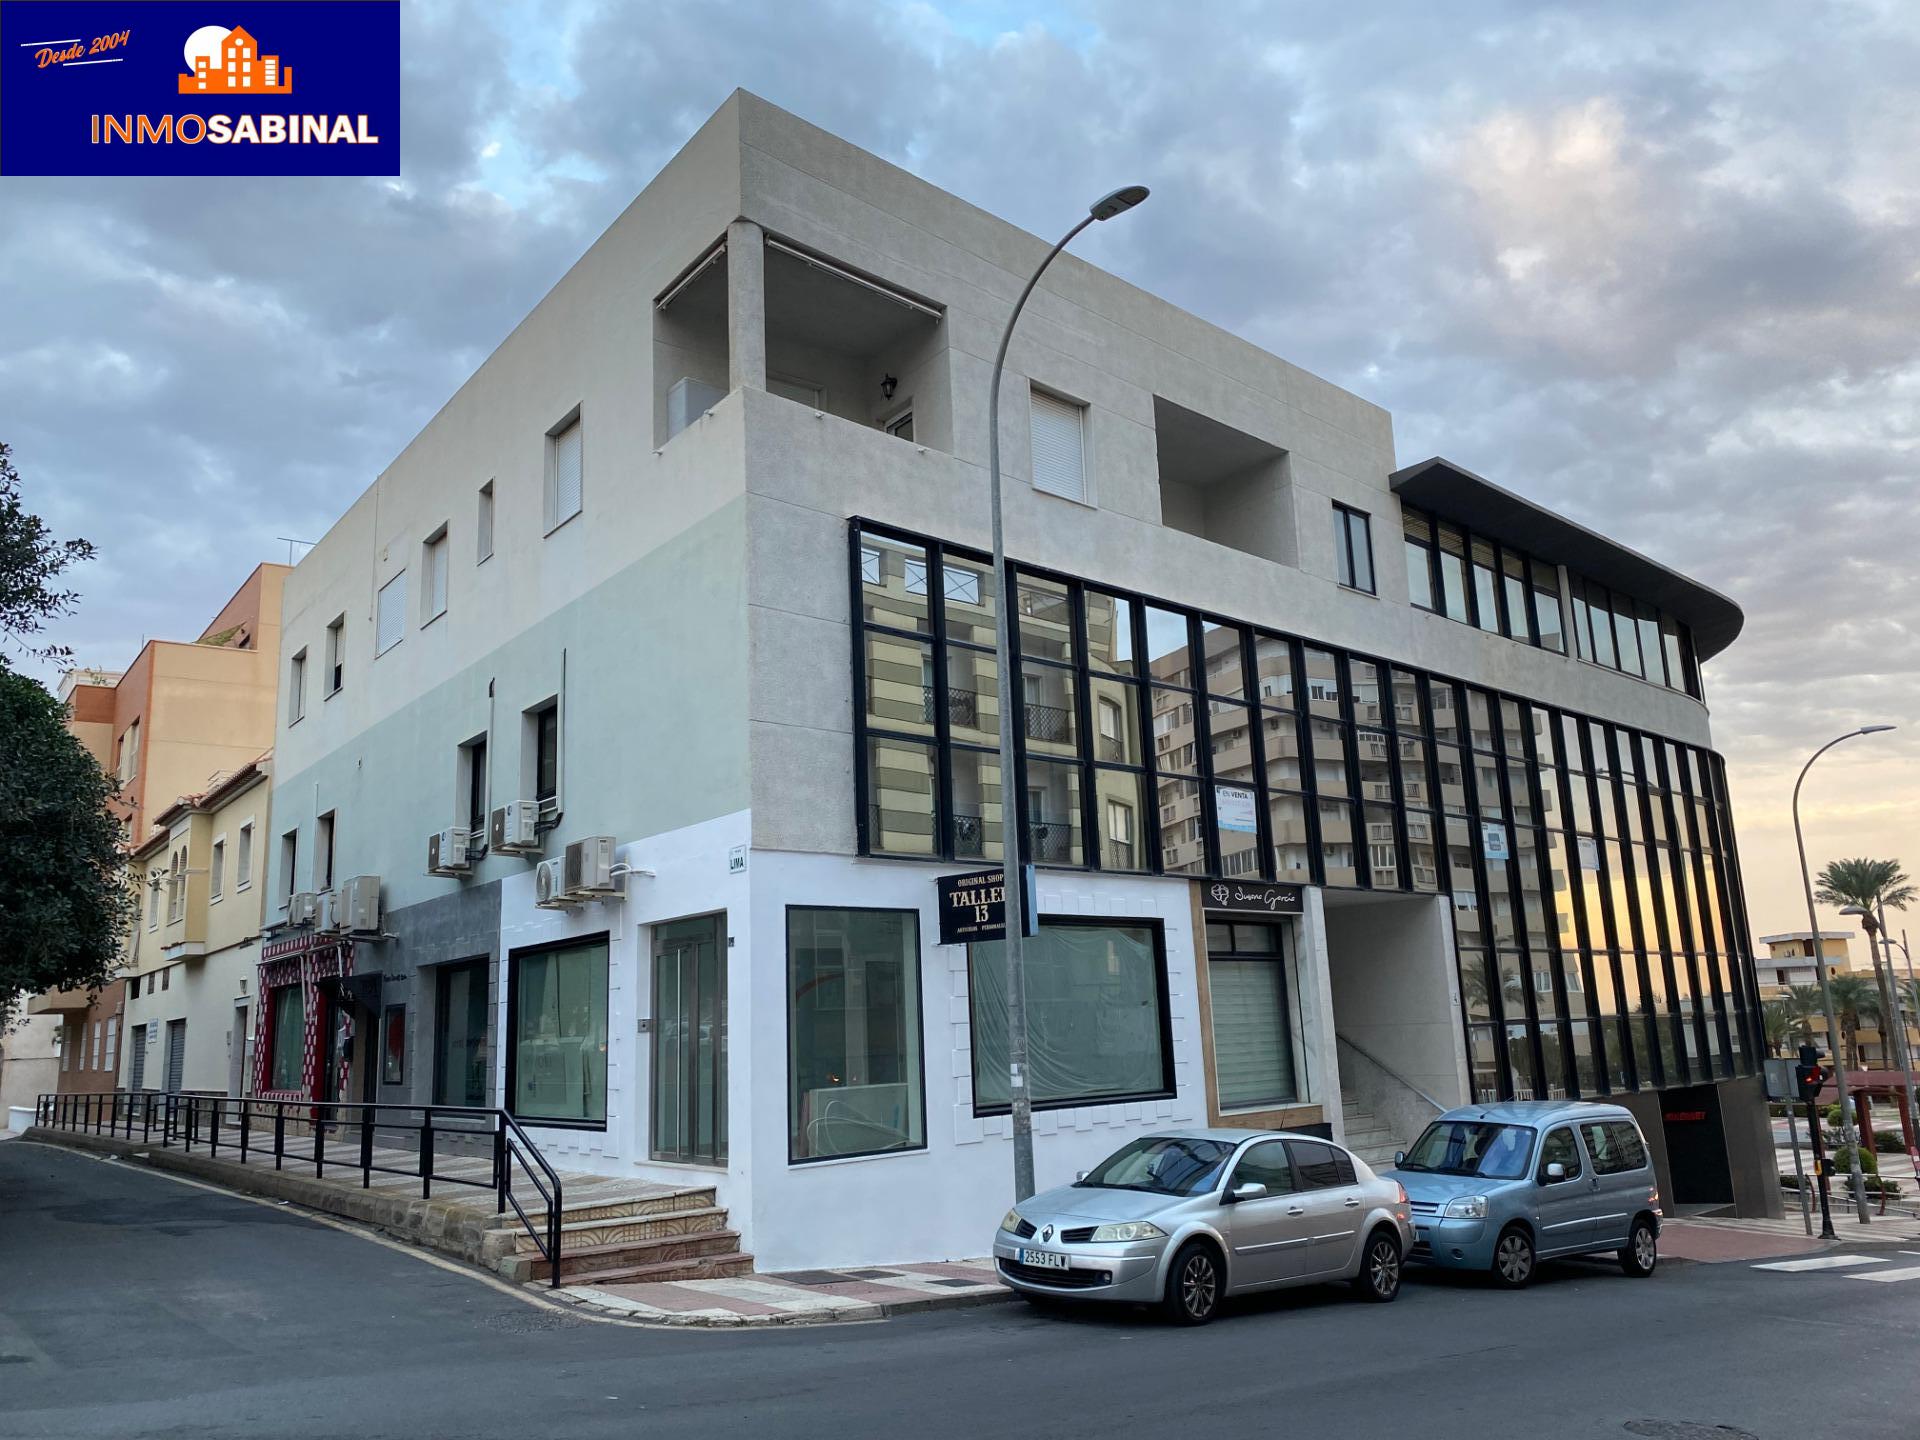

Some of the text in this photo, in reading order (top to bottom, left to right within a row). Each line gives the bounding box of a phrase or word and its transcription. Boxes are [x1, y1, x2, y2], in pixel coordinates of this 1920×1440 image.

[1231, 791, 1249, 799] VENTA
[957, 873, 1004, 887] ORIGINAL SHOP
[975, 905, 989, 923] 13
[1025, 1251, 1046, 1265] 2553
